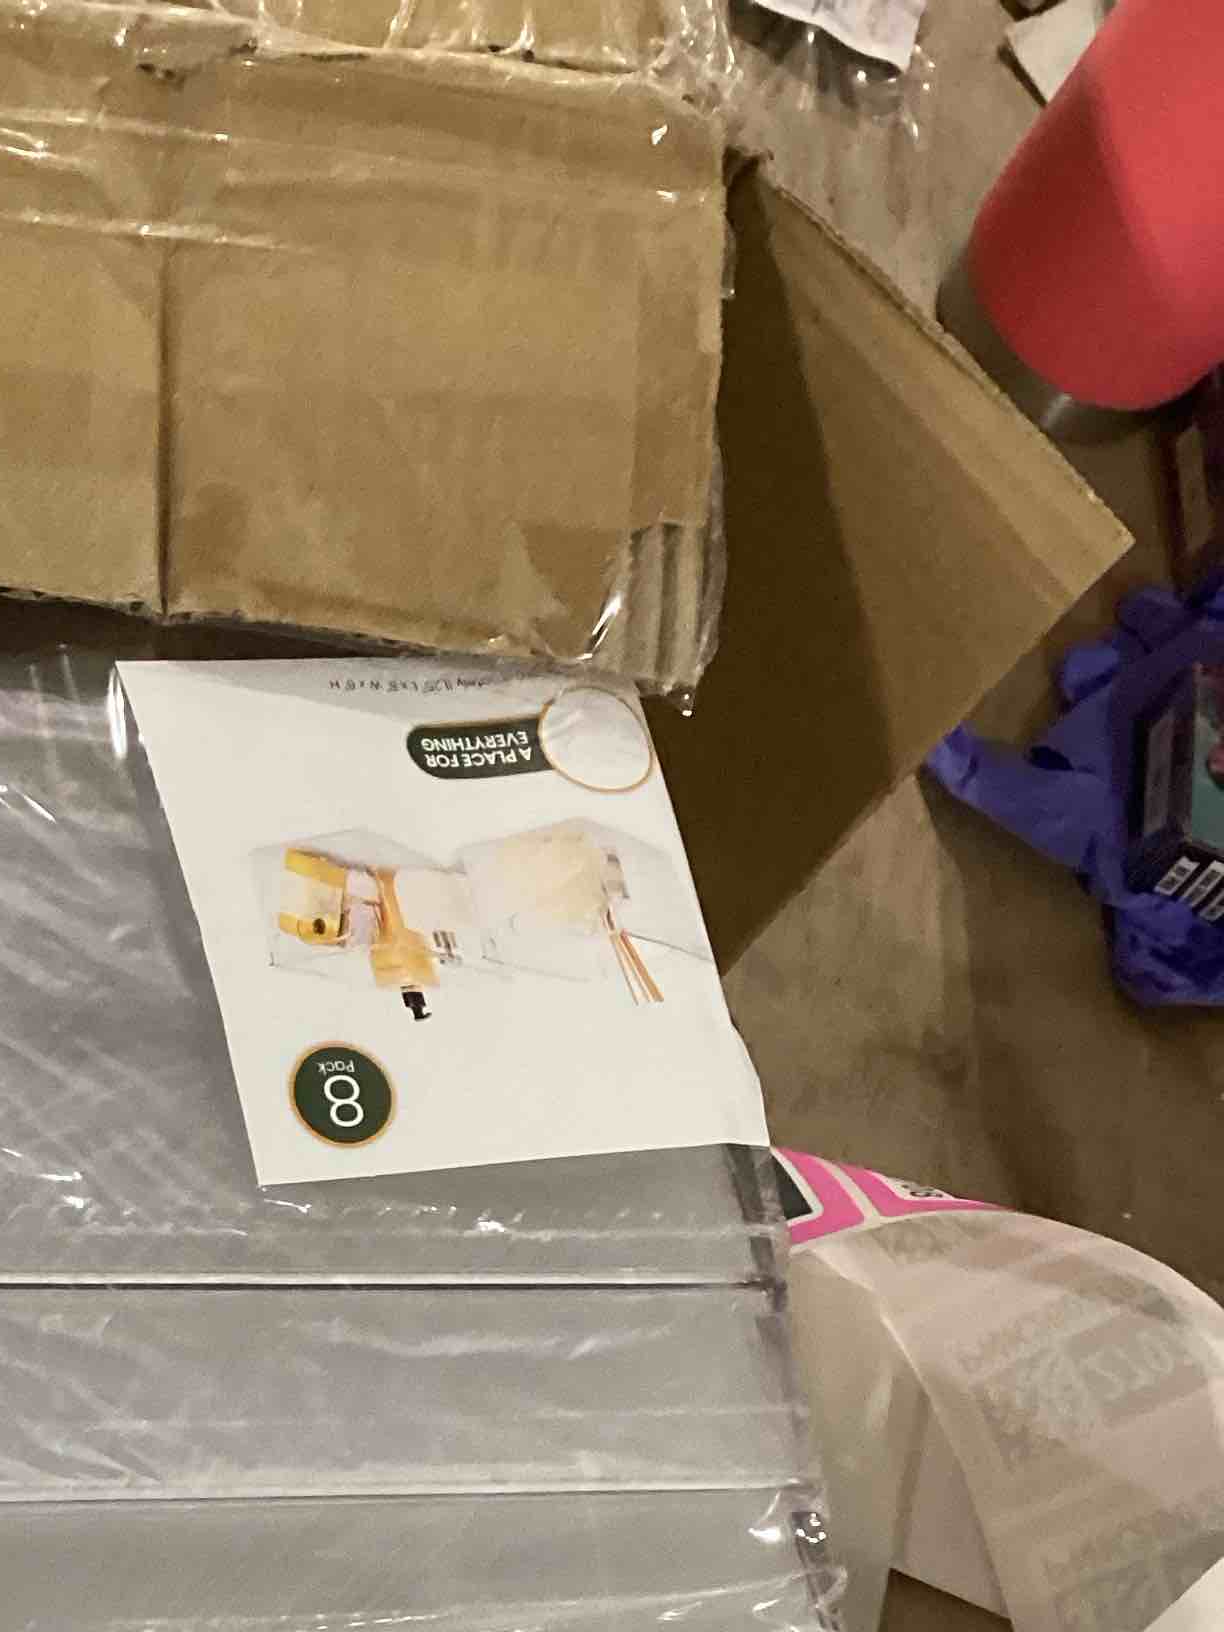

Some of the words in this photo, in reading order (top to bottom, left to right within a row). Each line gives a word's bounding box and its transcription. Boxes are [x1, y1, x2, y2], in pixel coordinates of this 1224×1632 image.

[421, 731, 529, 752] EVERYTHING
[424, 753, 459, 768] FOR
[463, 749, 518, 767] PLACE
[519, 747, 532, 760] A
[317, 1060, 355, 1076] Pack
[324, 1075, 364, 1128] 8
